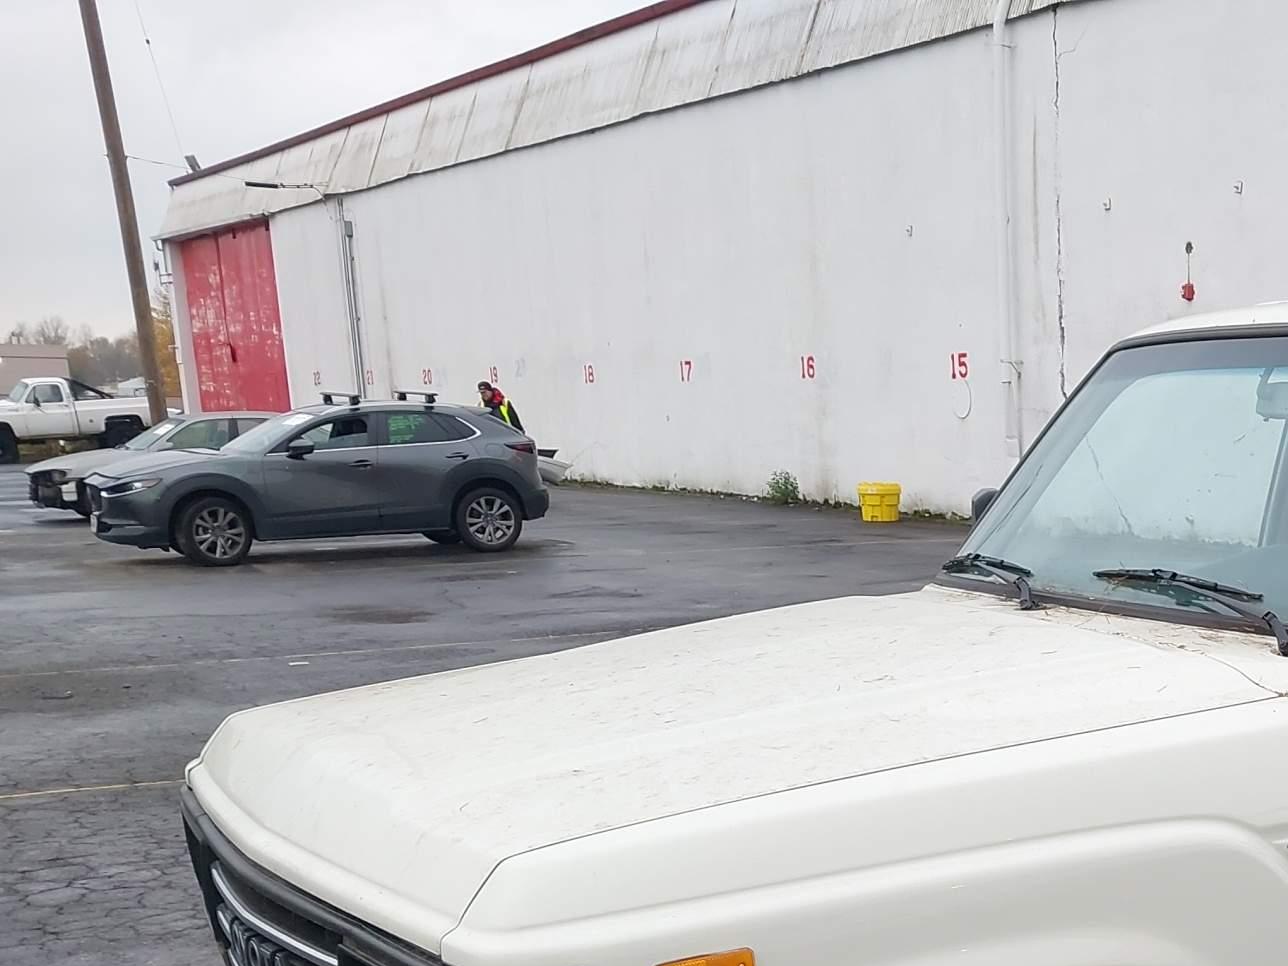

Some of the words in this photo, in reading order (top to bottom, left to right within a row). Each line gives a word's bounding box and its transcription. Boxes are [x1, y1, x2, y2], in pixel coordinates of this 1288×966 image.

[489, 366, 498, 384] 19
[584, 364, 595, 384] 18
[680, 360, 692, 382] 17
[800, 355, 815, 379] 16
[950, 352, 968, 380] 15
[422, 369, 433, 385] 20
